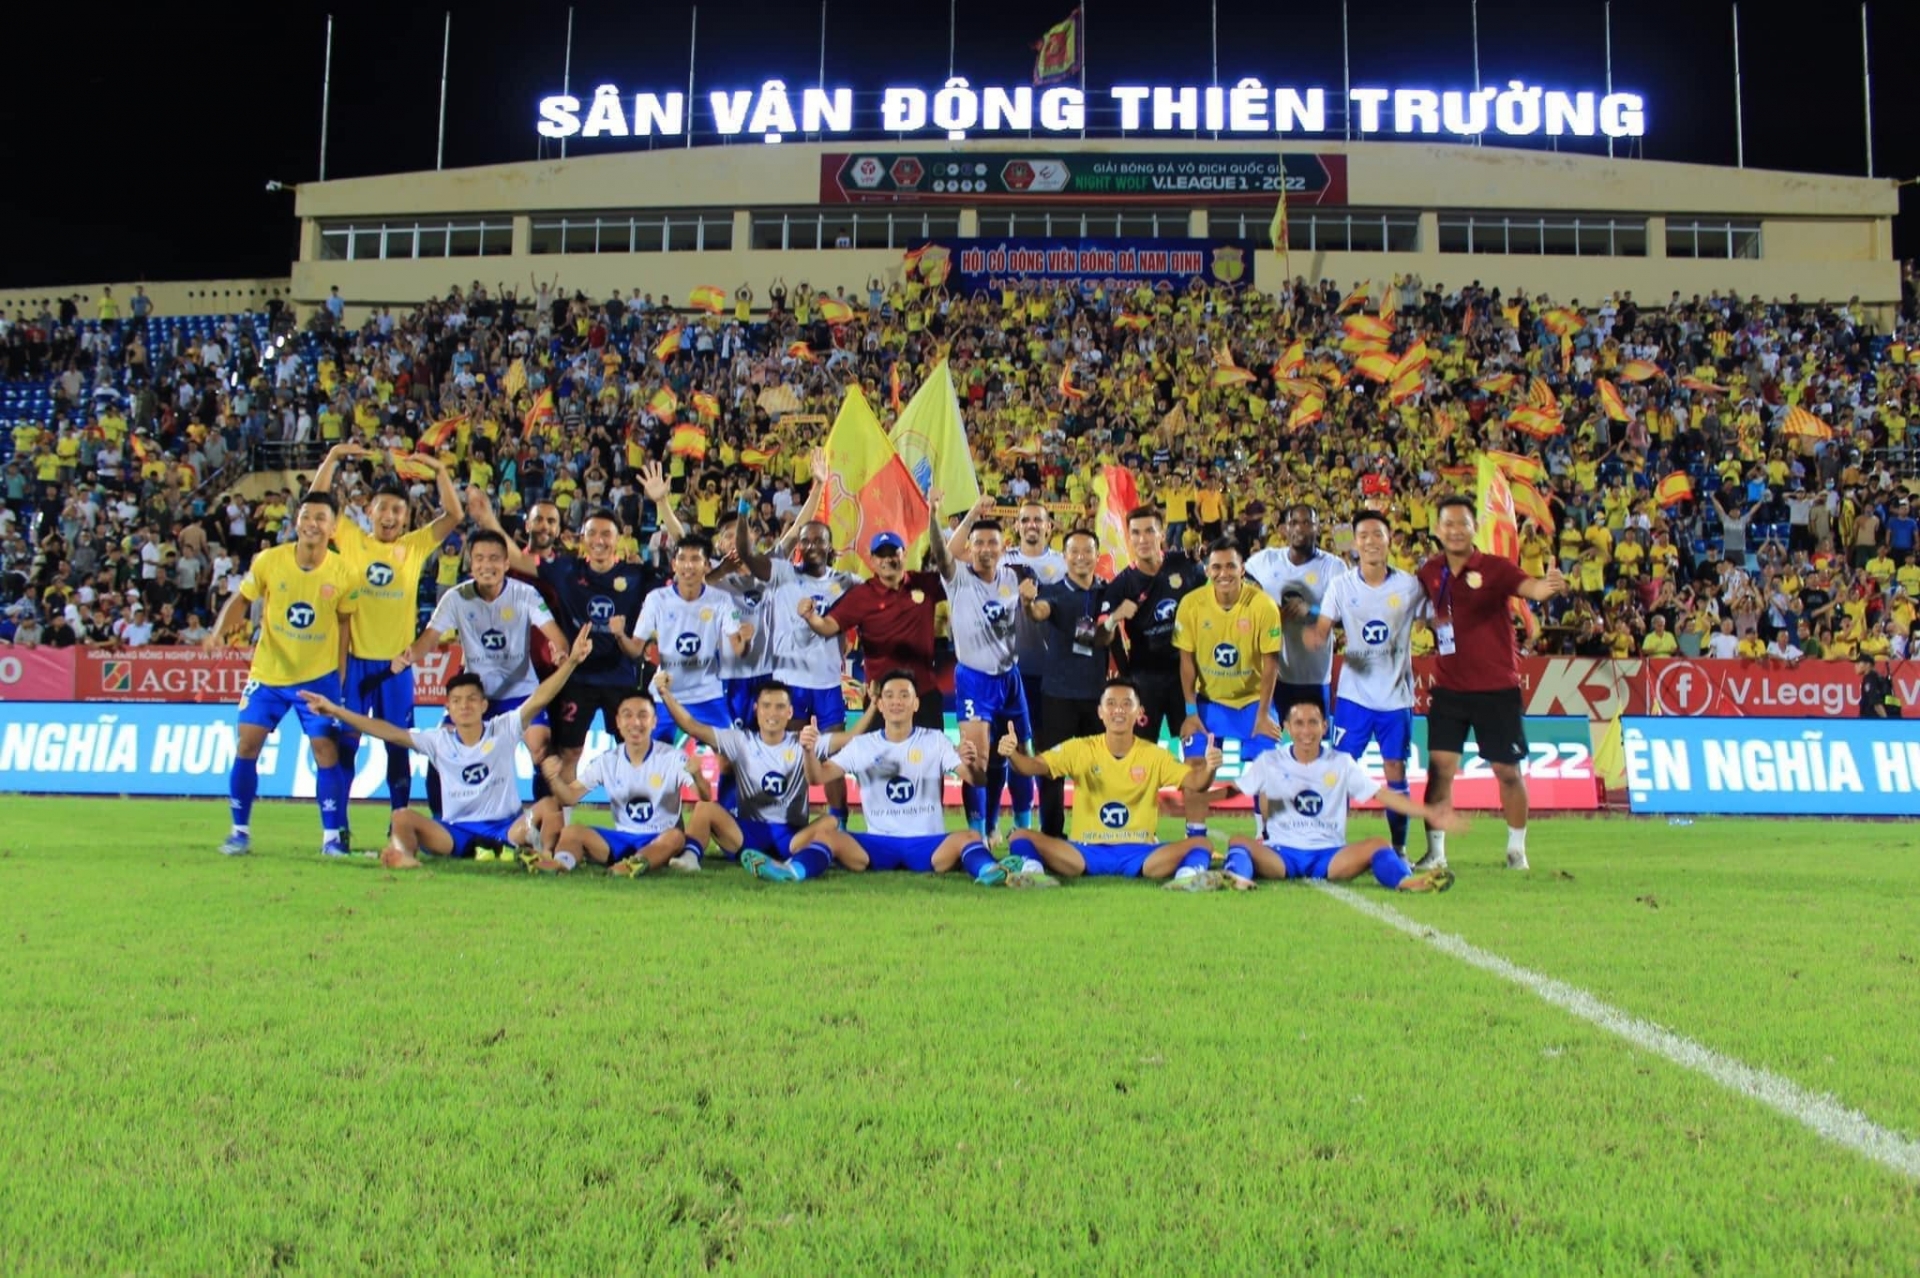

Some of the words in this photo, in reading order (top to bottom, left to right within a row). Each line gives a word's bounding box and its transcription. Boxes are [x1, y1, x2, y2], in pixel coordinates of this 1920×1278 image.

[537, 84, 683, 138] SÂN
[710, 79, 853, 144] VẬN
[882, 77, 1086, 141] ĐỘNG
[1111, 78, 1325, 132] THIÊN
[1350, 81, 1645, 137] TRƯỜNG
[1075, 176, 1111, 190] NIGHT
[1152, 176, 1237, 190] V.LEAGUE
[1239, 176, 1249, 190] 1
[1263, 177, 1306, 190] 2022
[1120, 162, 1154, 173] BÓNG
[1178, 161, 1196, 174] VÔ
[1229, 161, 1264, 174] QUỐC
[961, 246, 986, 278] HỘI
[987, 243, 1006, 274] CỔ
[1007, 246, 1045, 278] ĐỘNG
[1046, 246, 1078, 274] VIÊN
[1079, 246, 1116, 274] BÓNG
[1117, 246, 1137, 274] ĐÁ
[1138, 250, 1169, 274] NAM
[1170, 250, 1203, 278] ĐỊNH
[965, 699, 976, 718] 3
[0, 713, 138, 773] NGHĨA
[1703, 731, 1864, 792] NGHĨA
